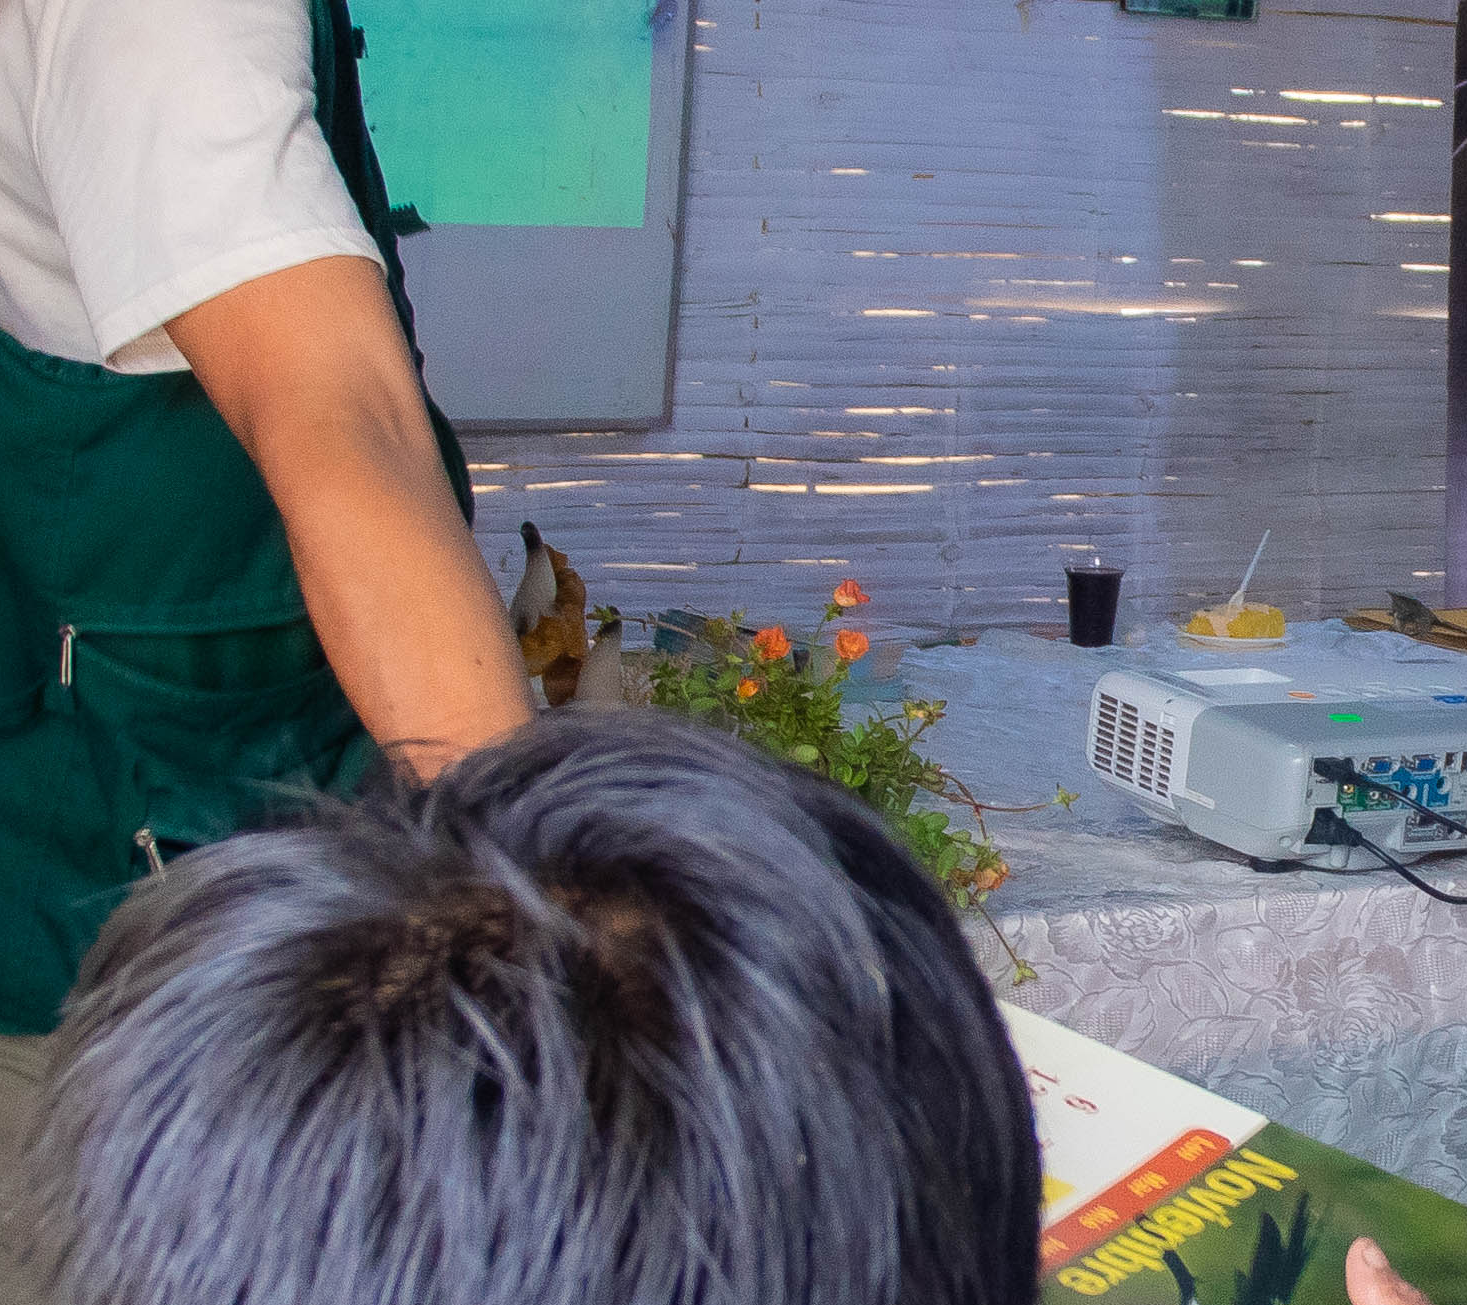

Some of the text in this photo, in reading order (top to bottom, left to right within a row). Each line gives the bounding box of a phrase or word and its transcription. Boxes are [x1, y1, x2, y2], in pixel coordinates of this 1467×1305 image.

[1176, 1134, 1217, 1162] Lun
[1126, 1170, 1169, 1198] Mar
[1056, 1147, 1299, 1296] Noviembre
